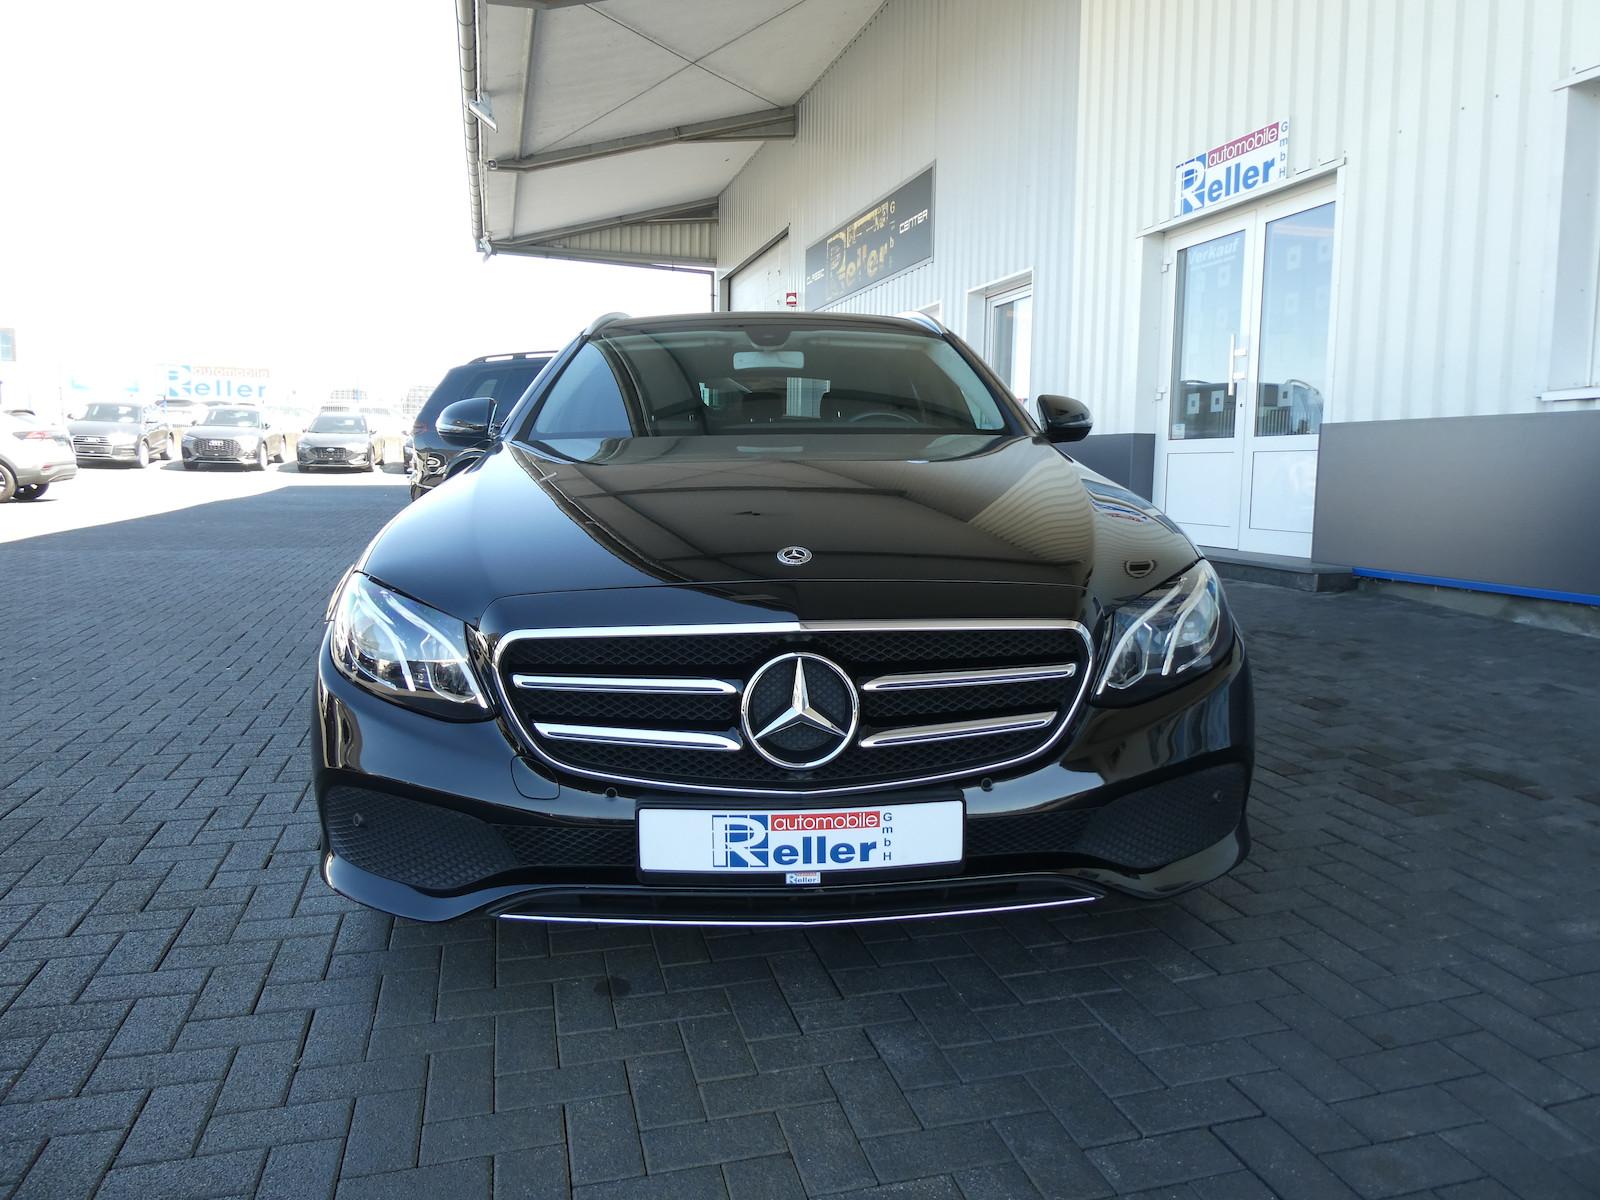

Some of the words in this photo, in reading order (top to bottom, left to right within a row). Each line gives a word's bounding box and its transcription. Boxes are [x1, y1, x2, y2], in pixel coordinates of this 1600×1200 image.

[1208, 126, 1278, 167] automobile
[1174, 156, 1276, 217] Reller
[899, 208, 928, 234] CENTER
[1187, 236, 1240, 265] Verkauf
[165, 364, 267, 398] Reller
[773, 811, 878, 831] automobile
[712, 814, 877, 868] Reller
